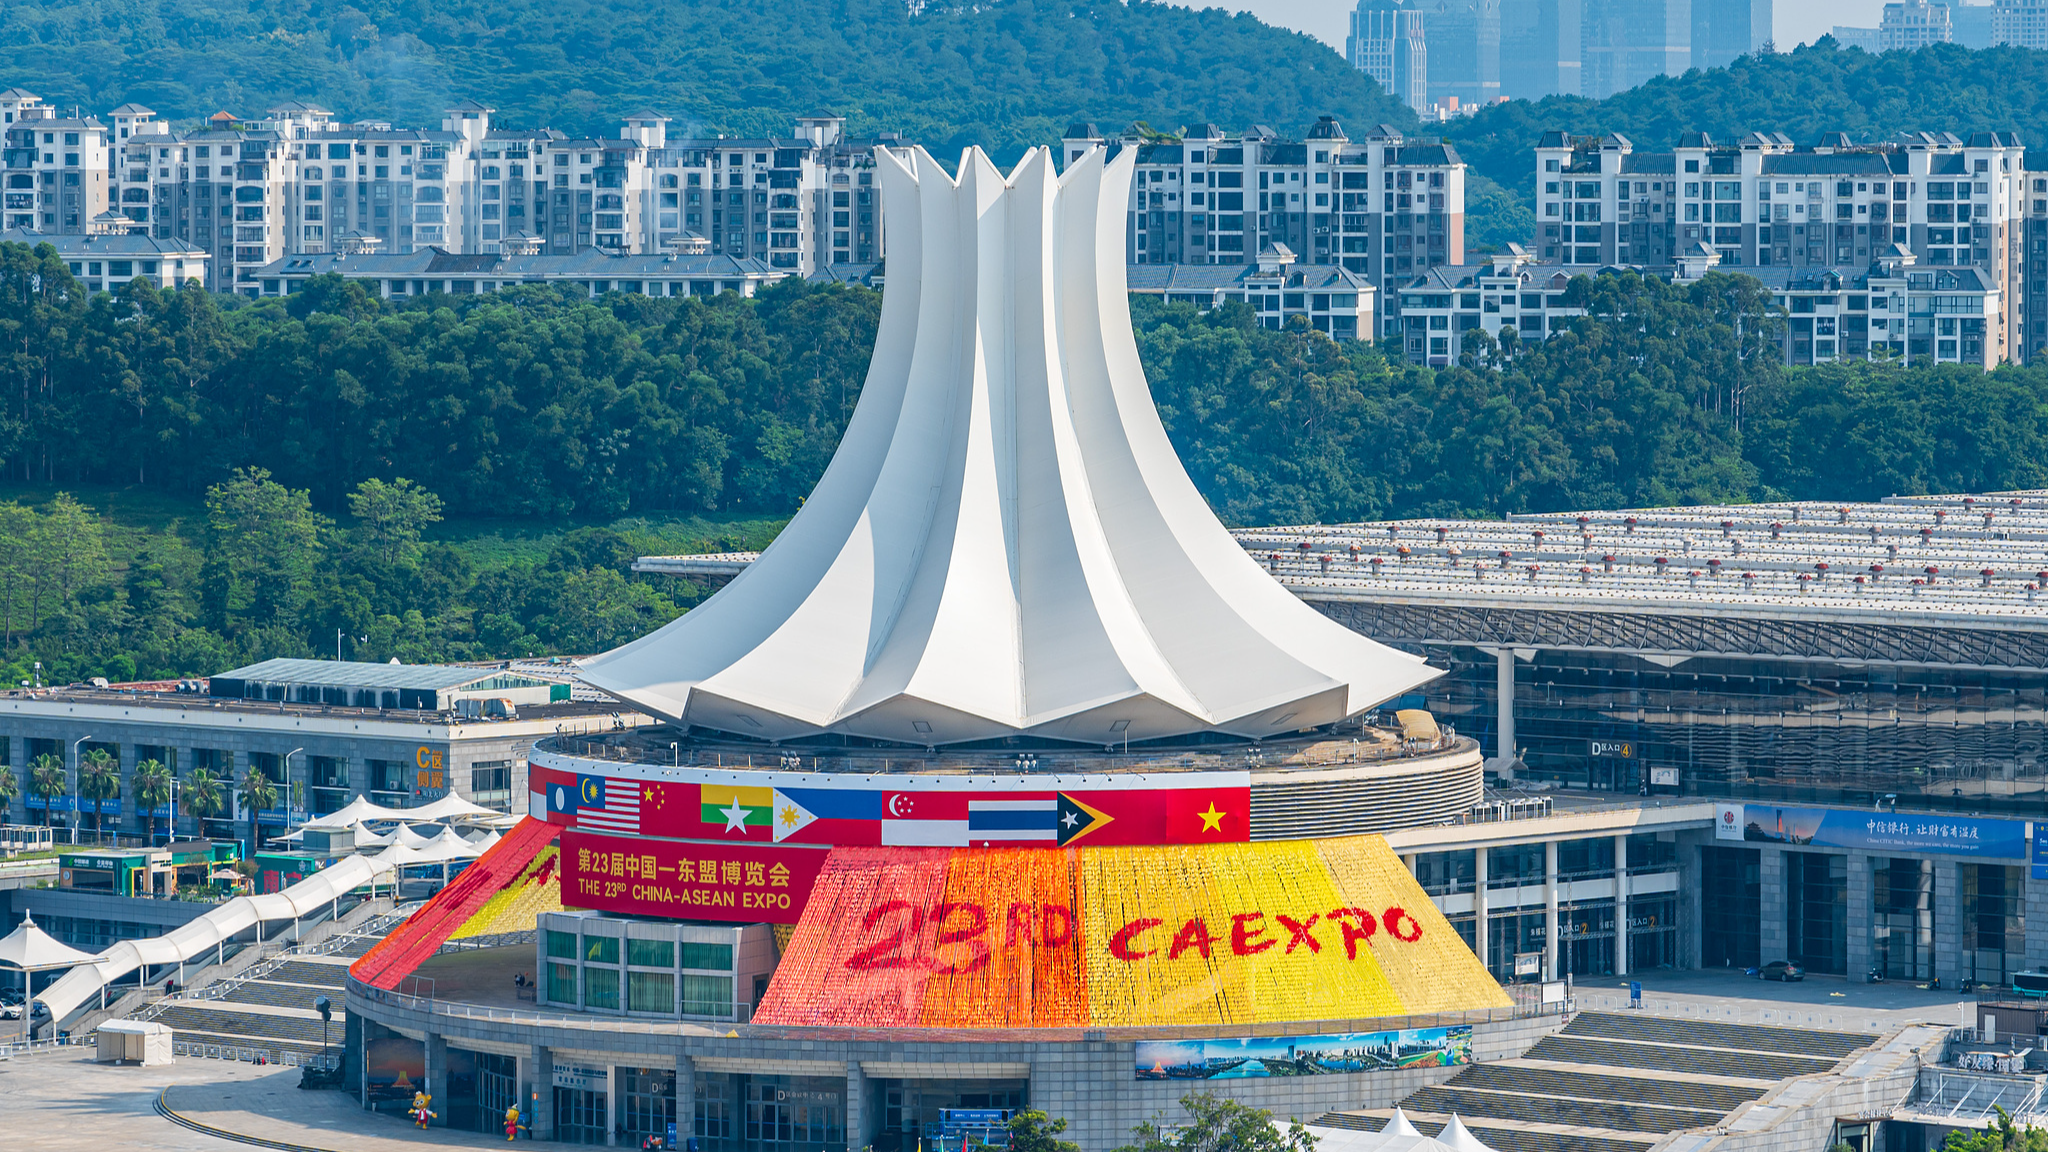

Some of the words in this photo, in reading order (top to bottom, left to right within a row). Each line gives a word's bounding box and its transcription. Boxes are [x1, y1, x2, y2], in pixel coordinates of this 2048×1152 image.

[578, 878, 600, 896] THE
[604, 881, 627, 898] 23RD
[632, 884, 735, 907] CHINA-ASEAN
[743, 892, 791, 910] EXPO
